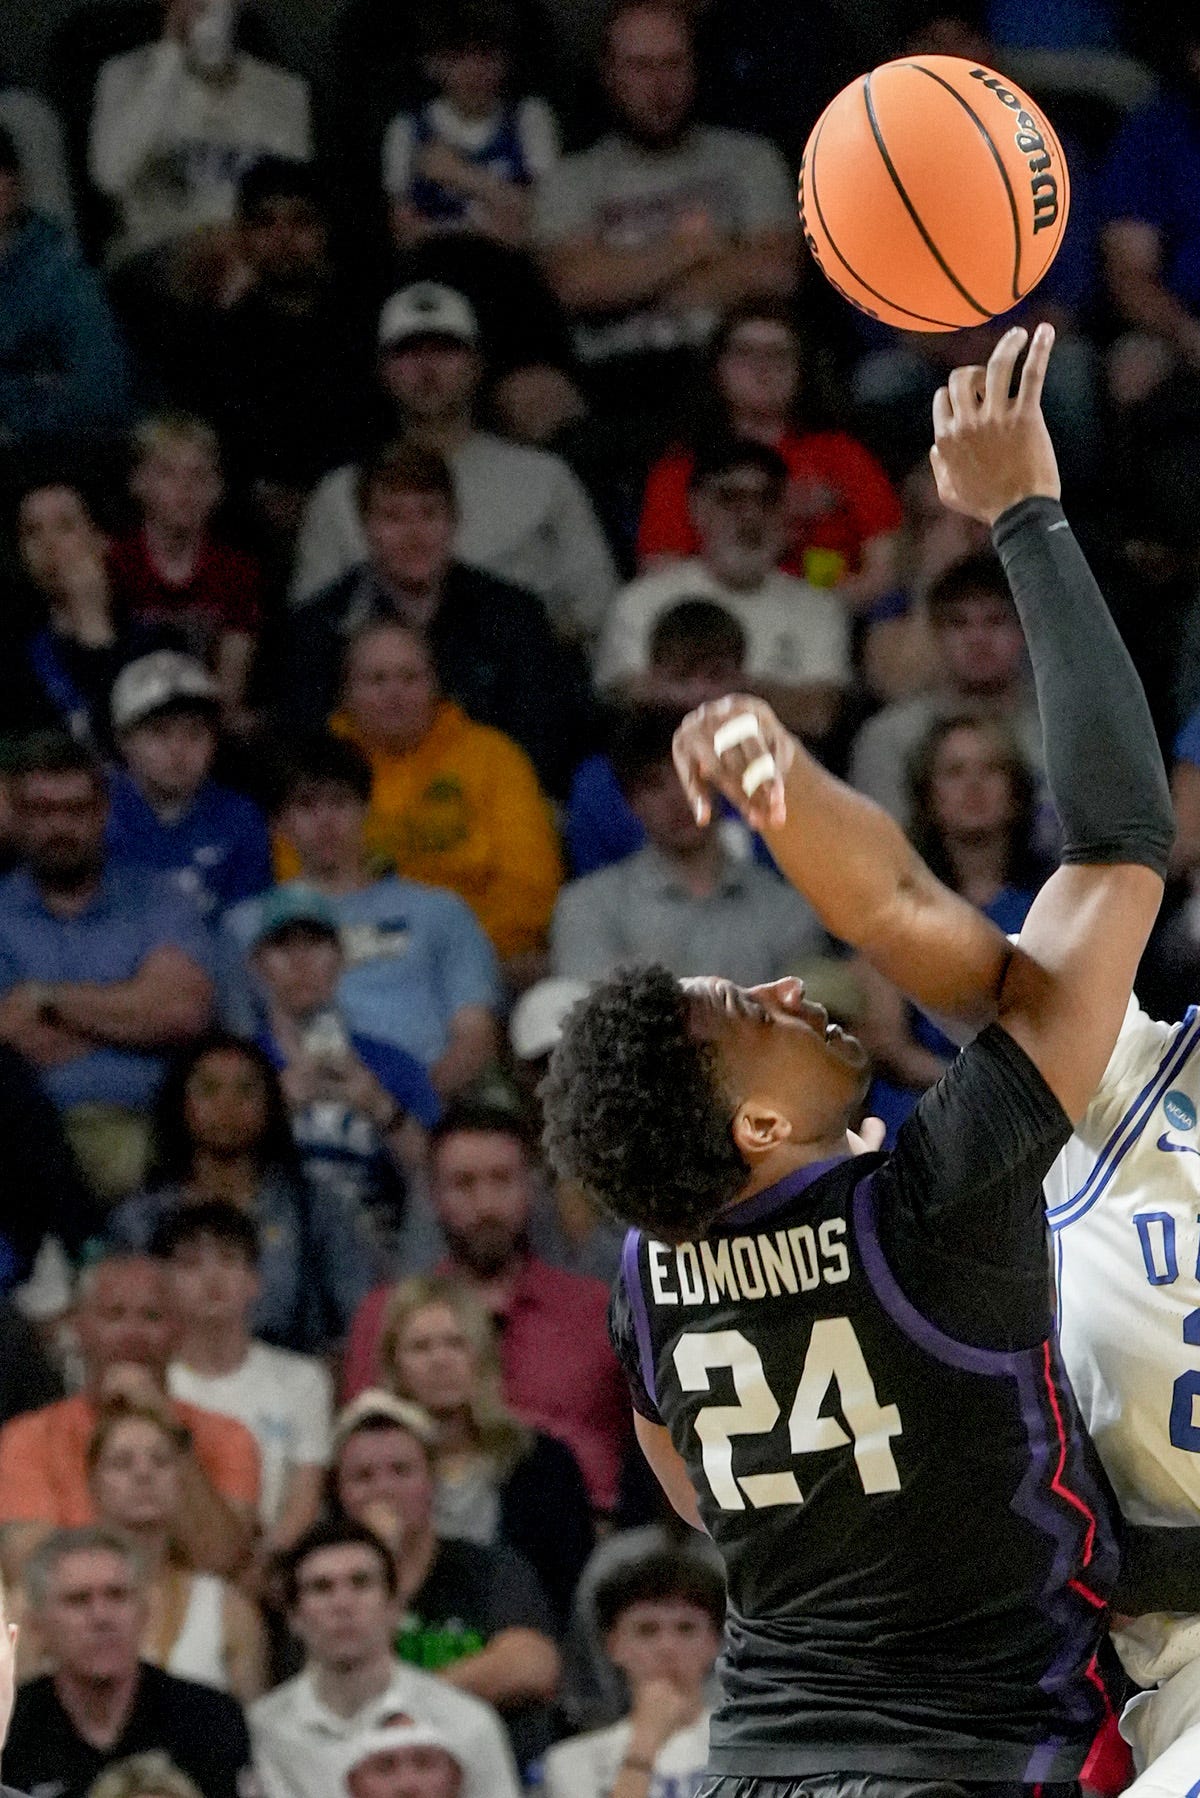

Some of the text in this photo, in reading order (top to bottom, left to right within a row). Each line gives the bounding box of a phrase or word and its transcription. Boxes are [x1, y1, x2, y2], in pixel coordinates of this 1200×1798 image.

[968, 68, 1058, 236] Wilson
[1166, 1100, 1193, 1128] NCAA
[648, 1217, 851, 1306] EDMONDS
[672, 1316, 903, 1511] 24
